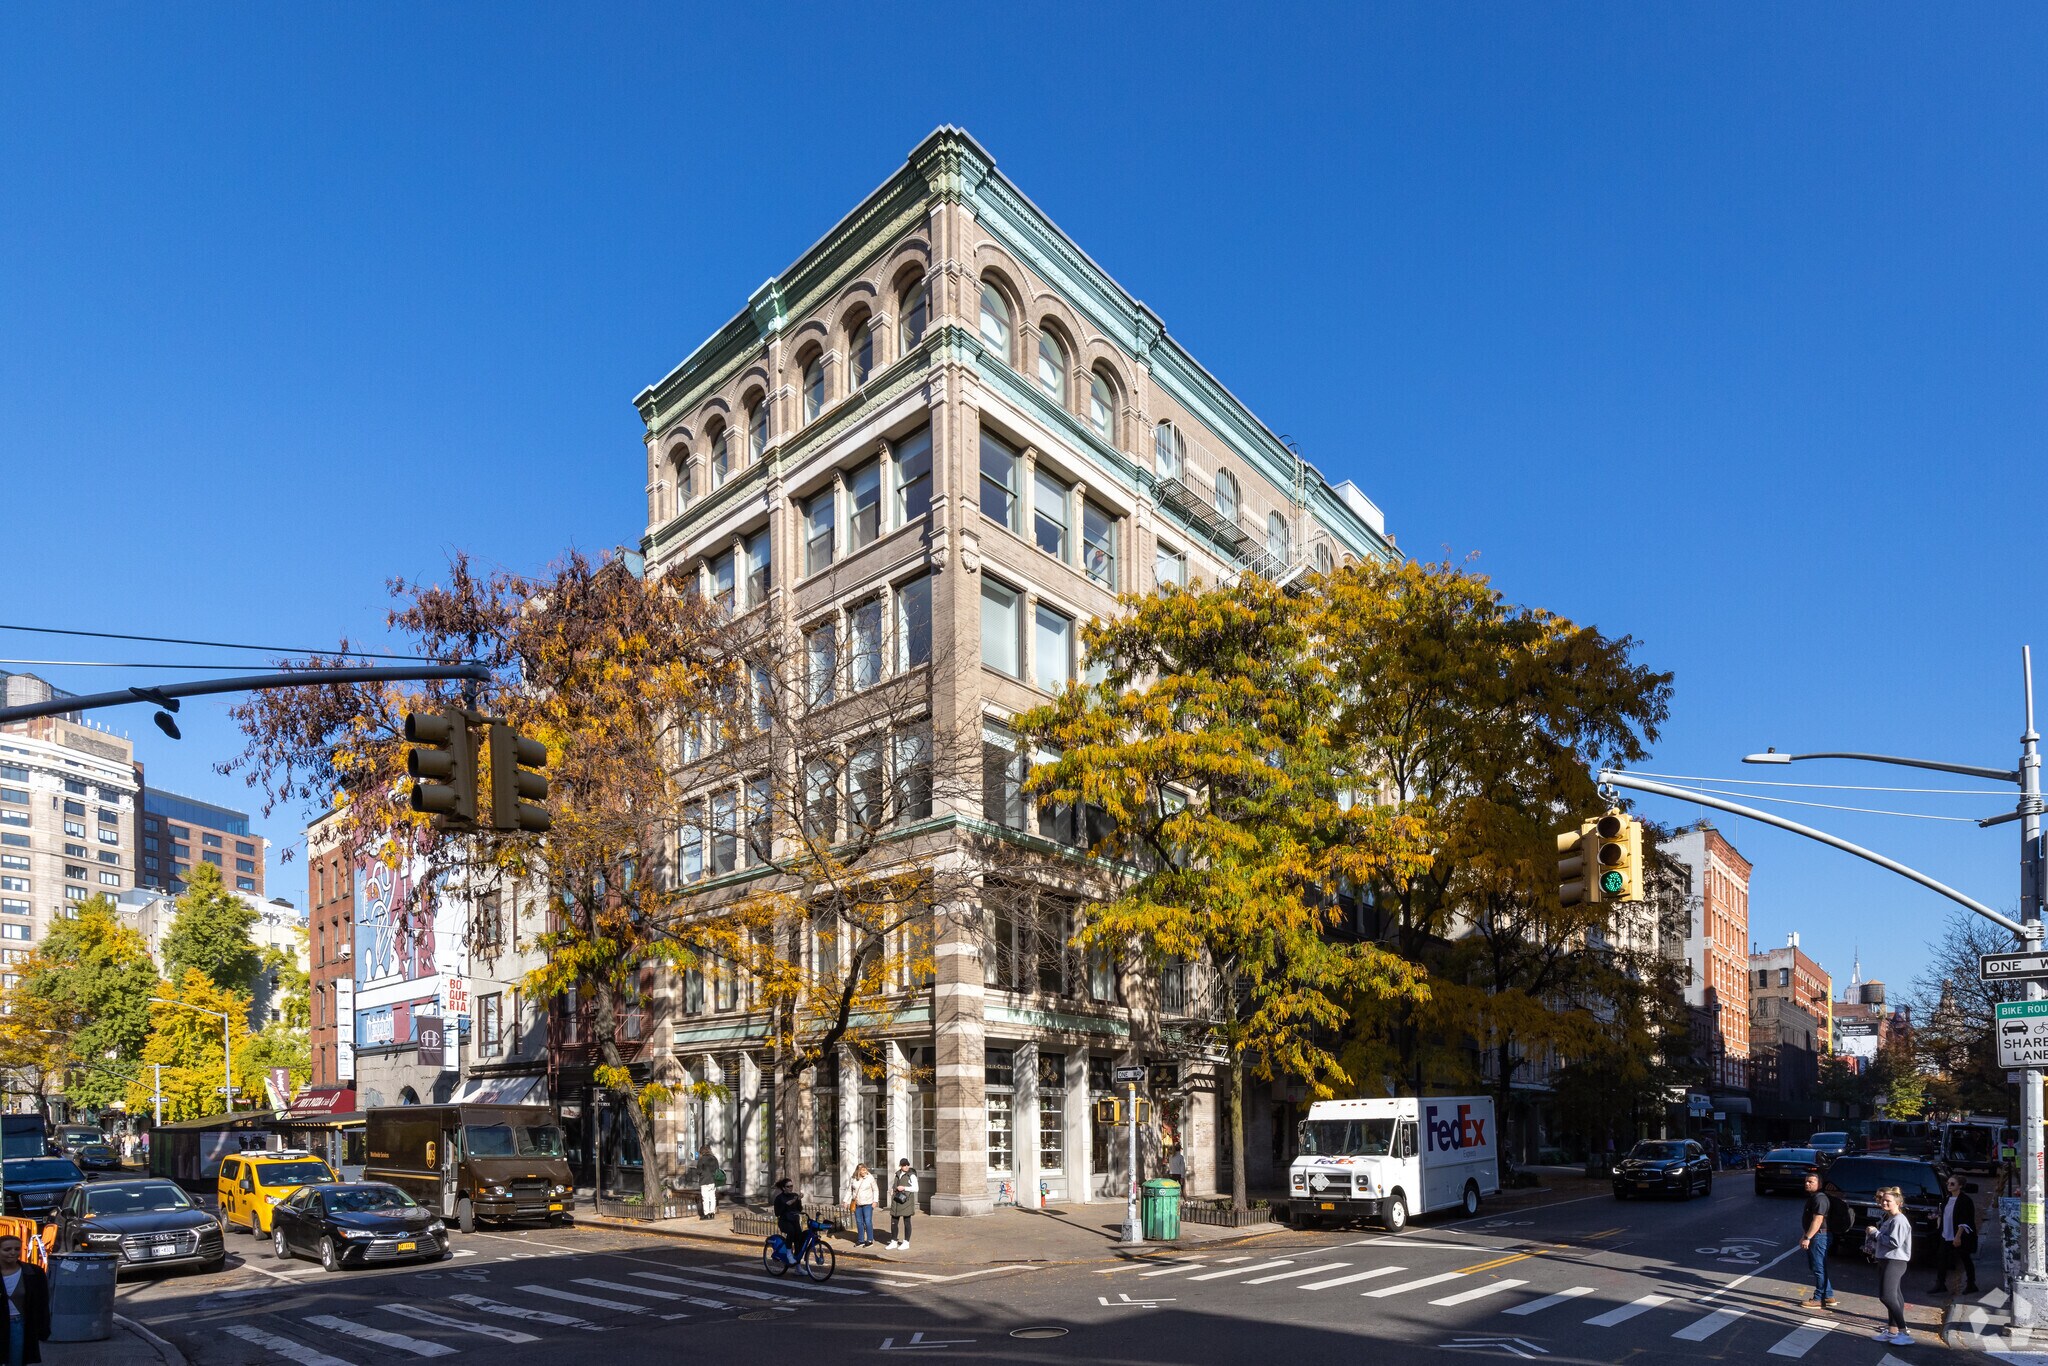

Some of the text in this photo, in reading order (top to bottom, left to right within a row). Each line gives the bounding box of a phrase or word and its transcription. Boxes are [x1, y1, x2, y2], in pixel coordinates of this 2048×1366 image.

[1990, 961, 2021, 972] ONE
[449, 979, 462, 989] BO
[449, 990, 468, 1002] QUE
[449, 1000, 467, 1012] RIA
[2001, 1006, 2023, 1015] BIKE
[1426, 1104, 1486, 1151] FedEx
